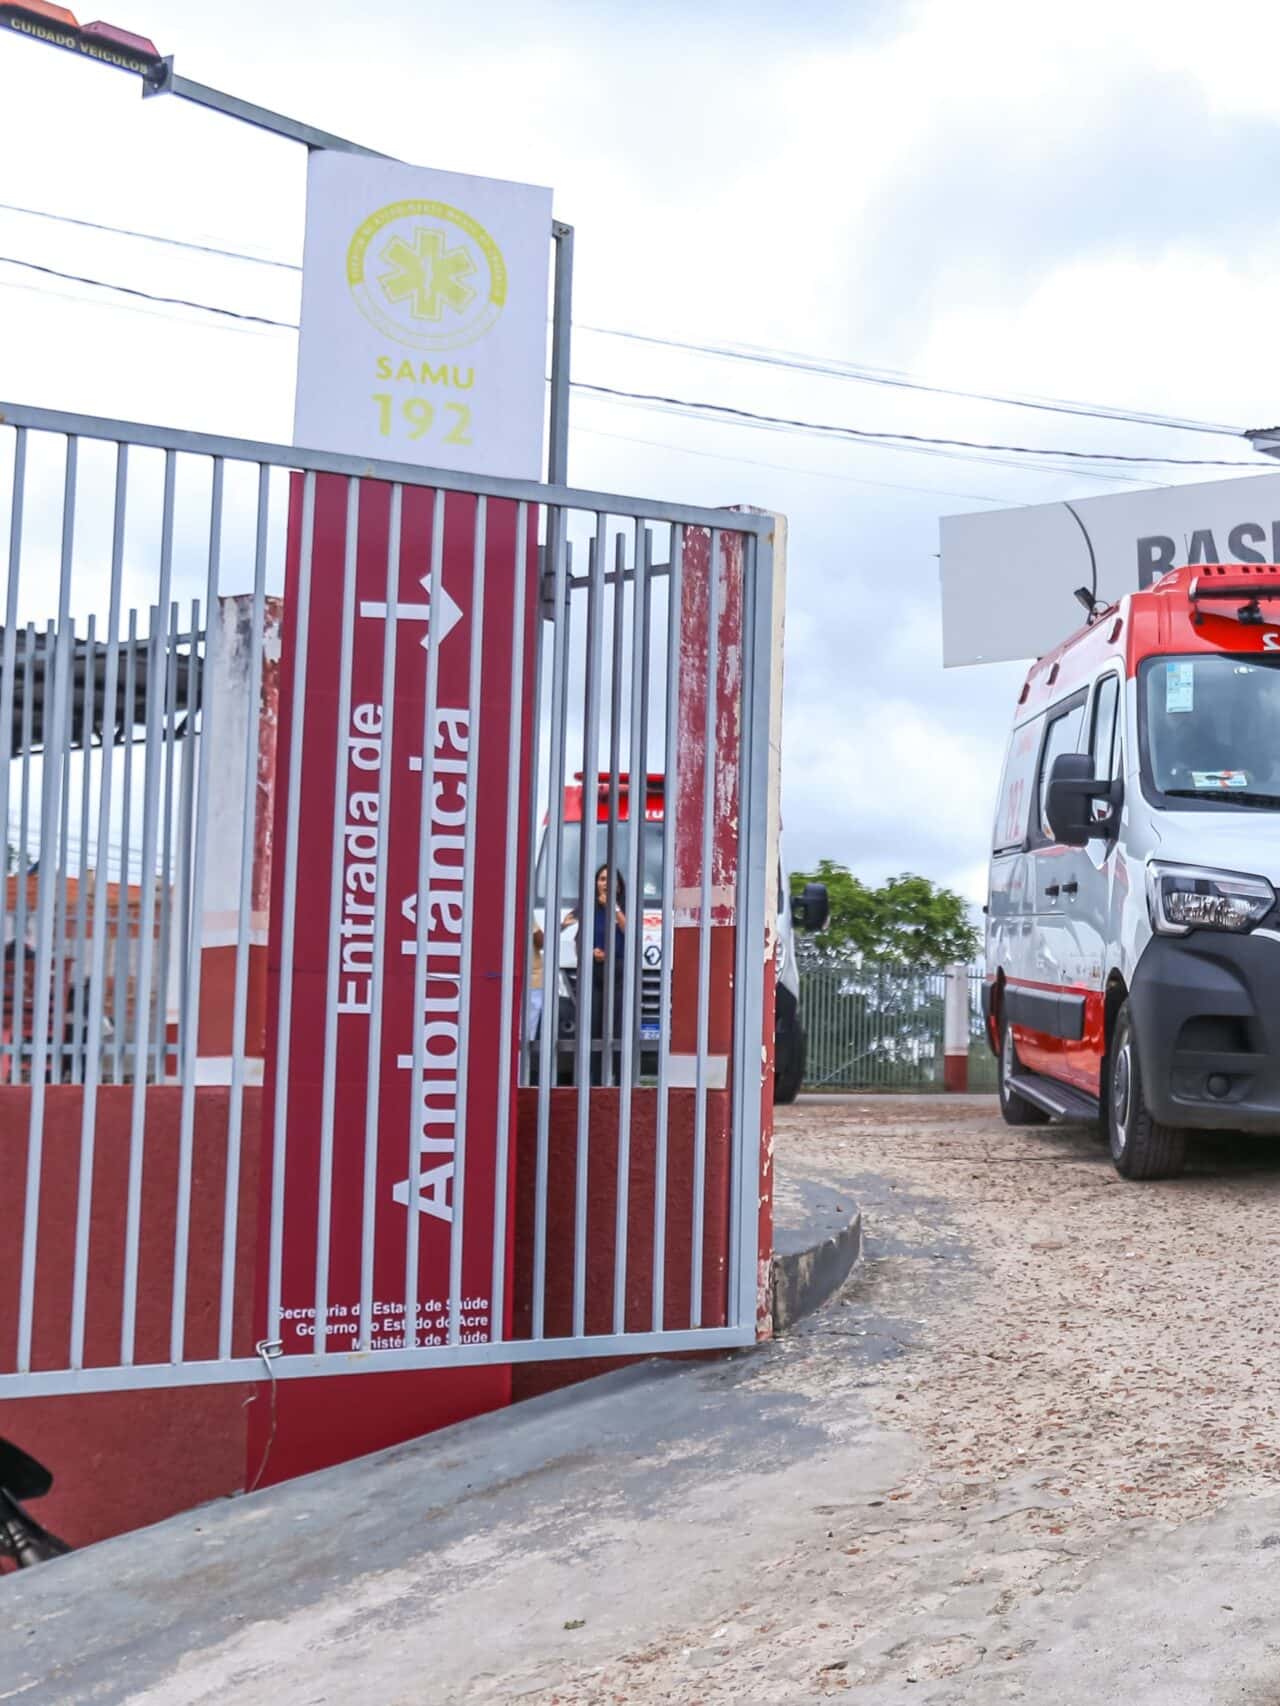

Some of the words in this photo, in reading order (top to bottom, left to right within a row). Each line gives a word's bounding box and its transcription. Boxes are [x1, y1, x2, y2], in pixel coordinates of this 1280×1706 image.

[11, 17, 76, 49] CUIDADO
[80, 42, 148, 74] VEICULOS
[375, 355, 475, 390] SAMU
[371, 394, 473, 446] 192
[348, 702, 384, 772] de
[337, 791, 381, 1015] Entrada
[392, 705, 471, 1225] Ambulância
[277, 1304, 347, 1320] Secreria
[425, 1299, 442, 1312] de
[296, 1322, 358, 1336] Goerno
[383, 1317, 432, 1333] Estdo
[424, 1333, 442, 1346] de
